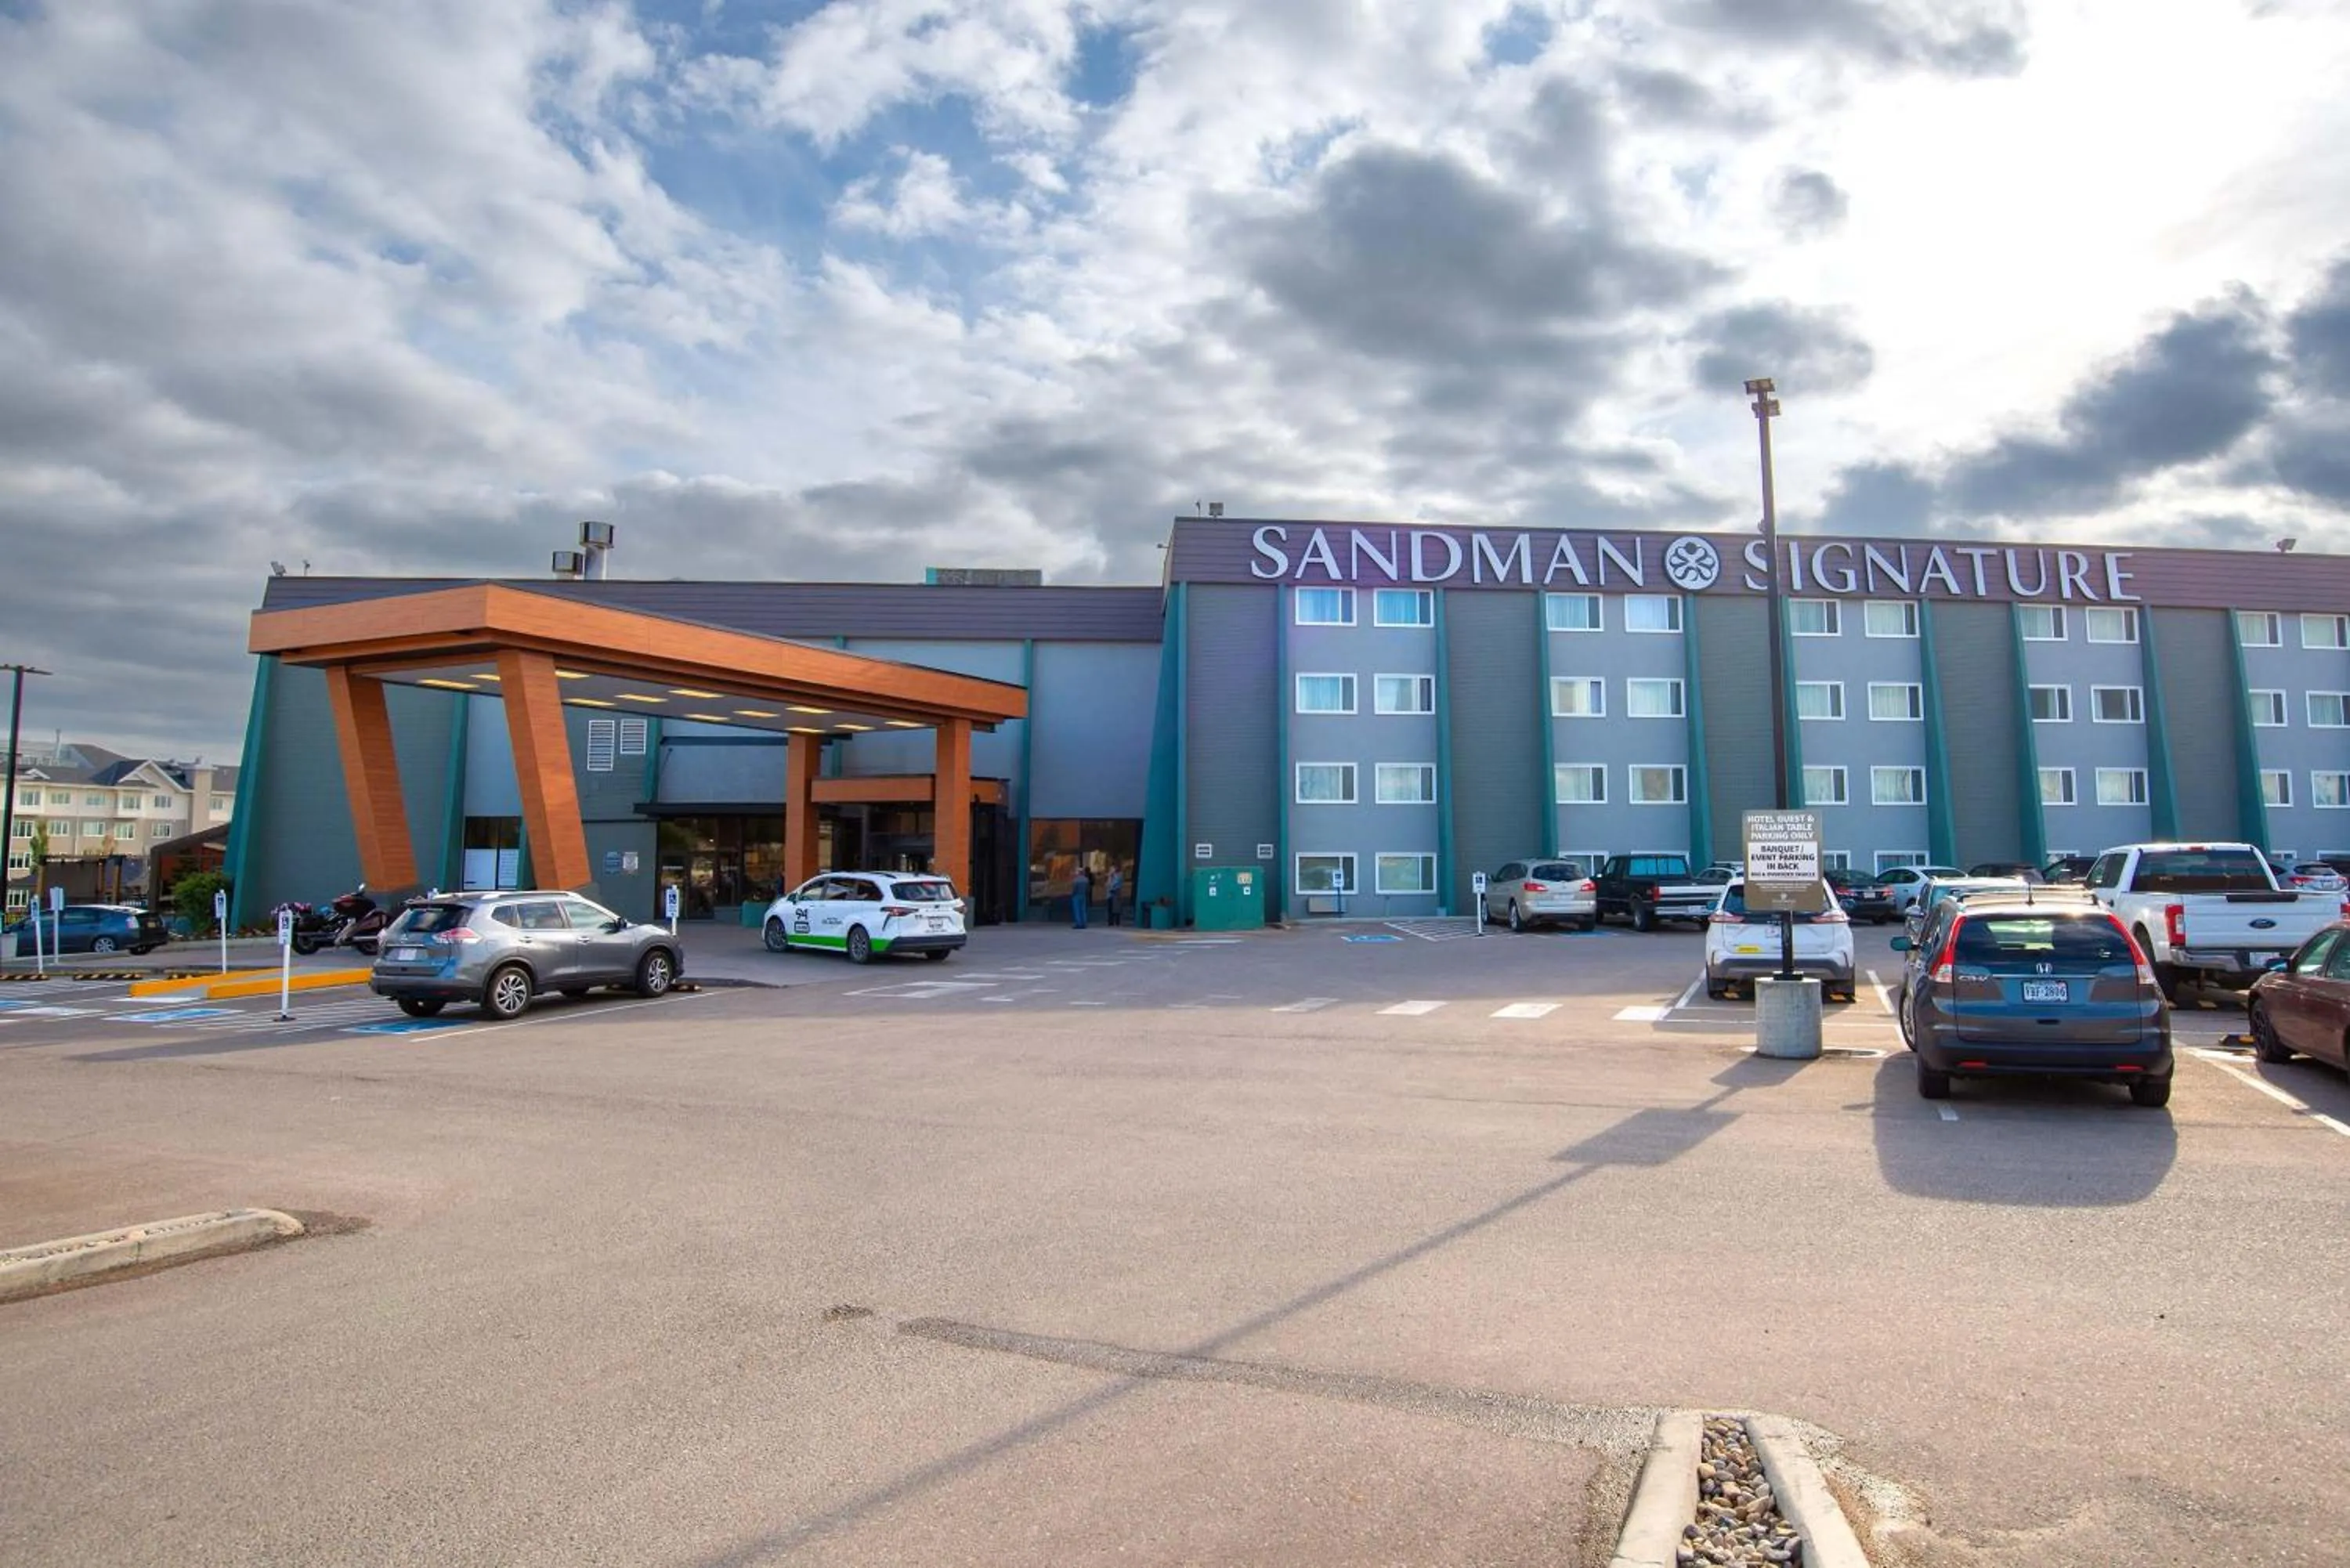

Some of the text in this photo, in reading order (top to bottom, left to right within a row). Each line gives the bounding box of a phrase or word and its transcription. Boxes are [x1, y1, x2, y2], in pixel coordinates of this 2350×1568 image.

[1250, 525, 2142, 601] SANDMAN SIGNATURE
[1777, 815, 1806, 823] GUEST
[795, 908, 808, 920] 94
